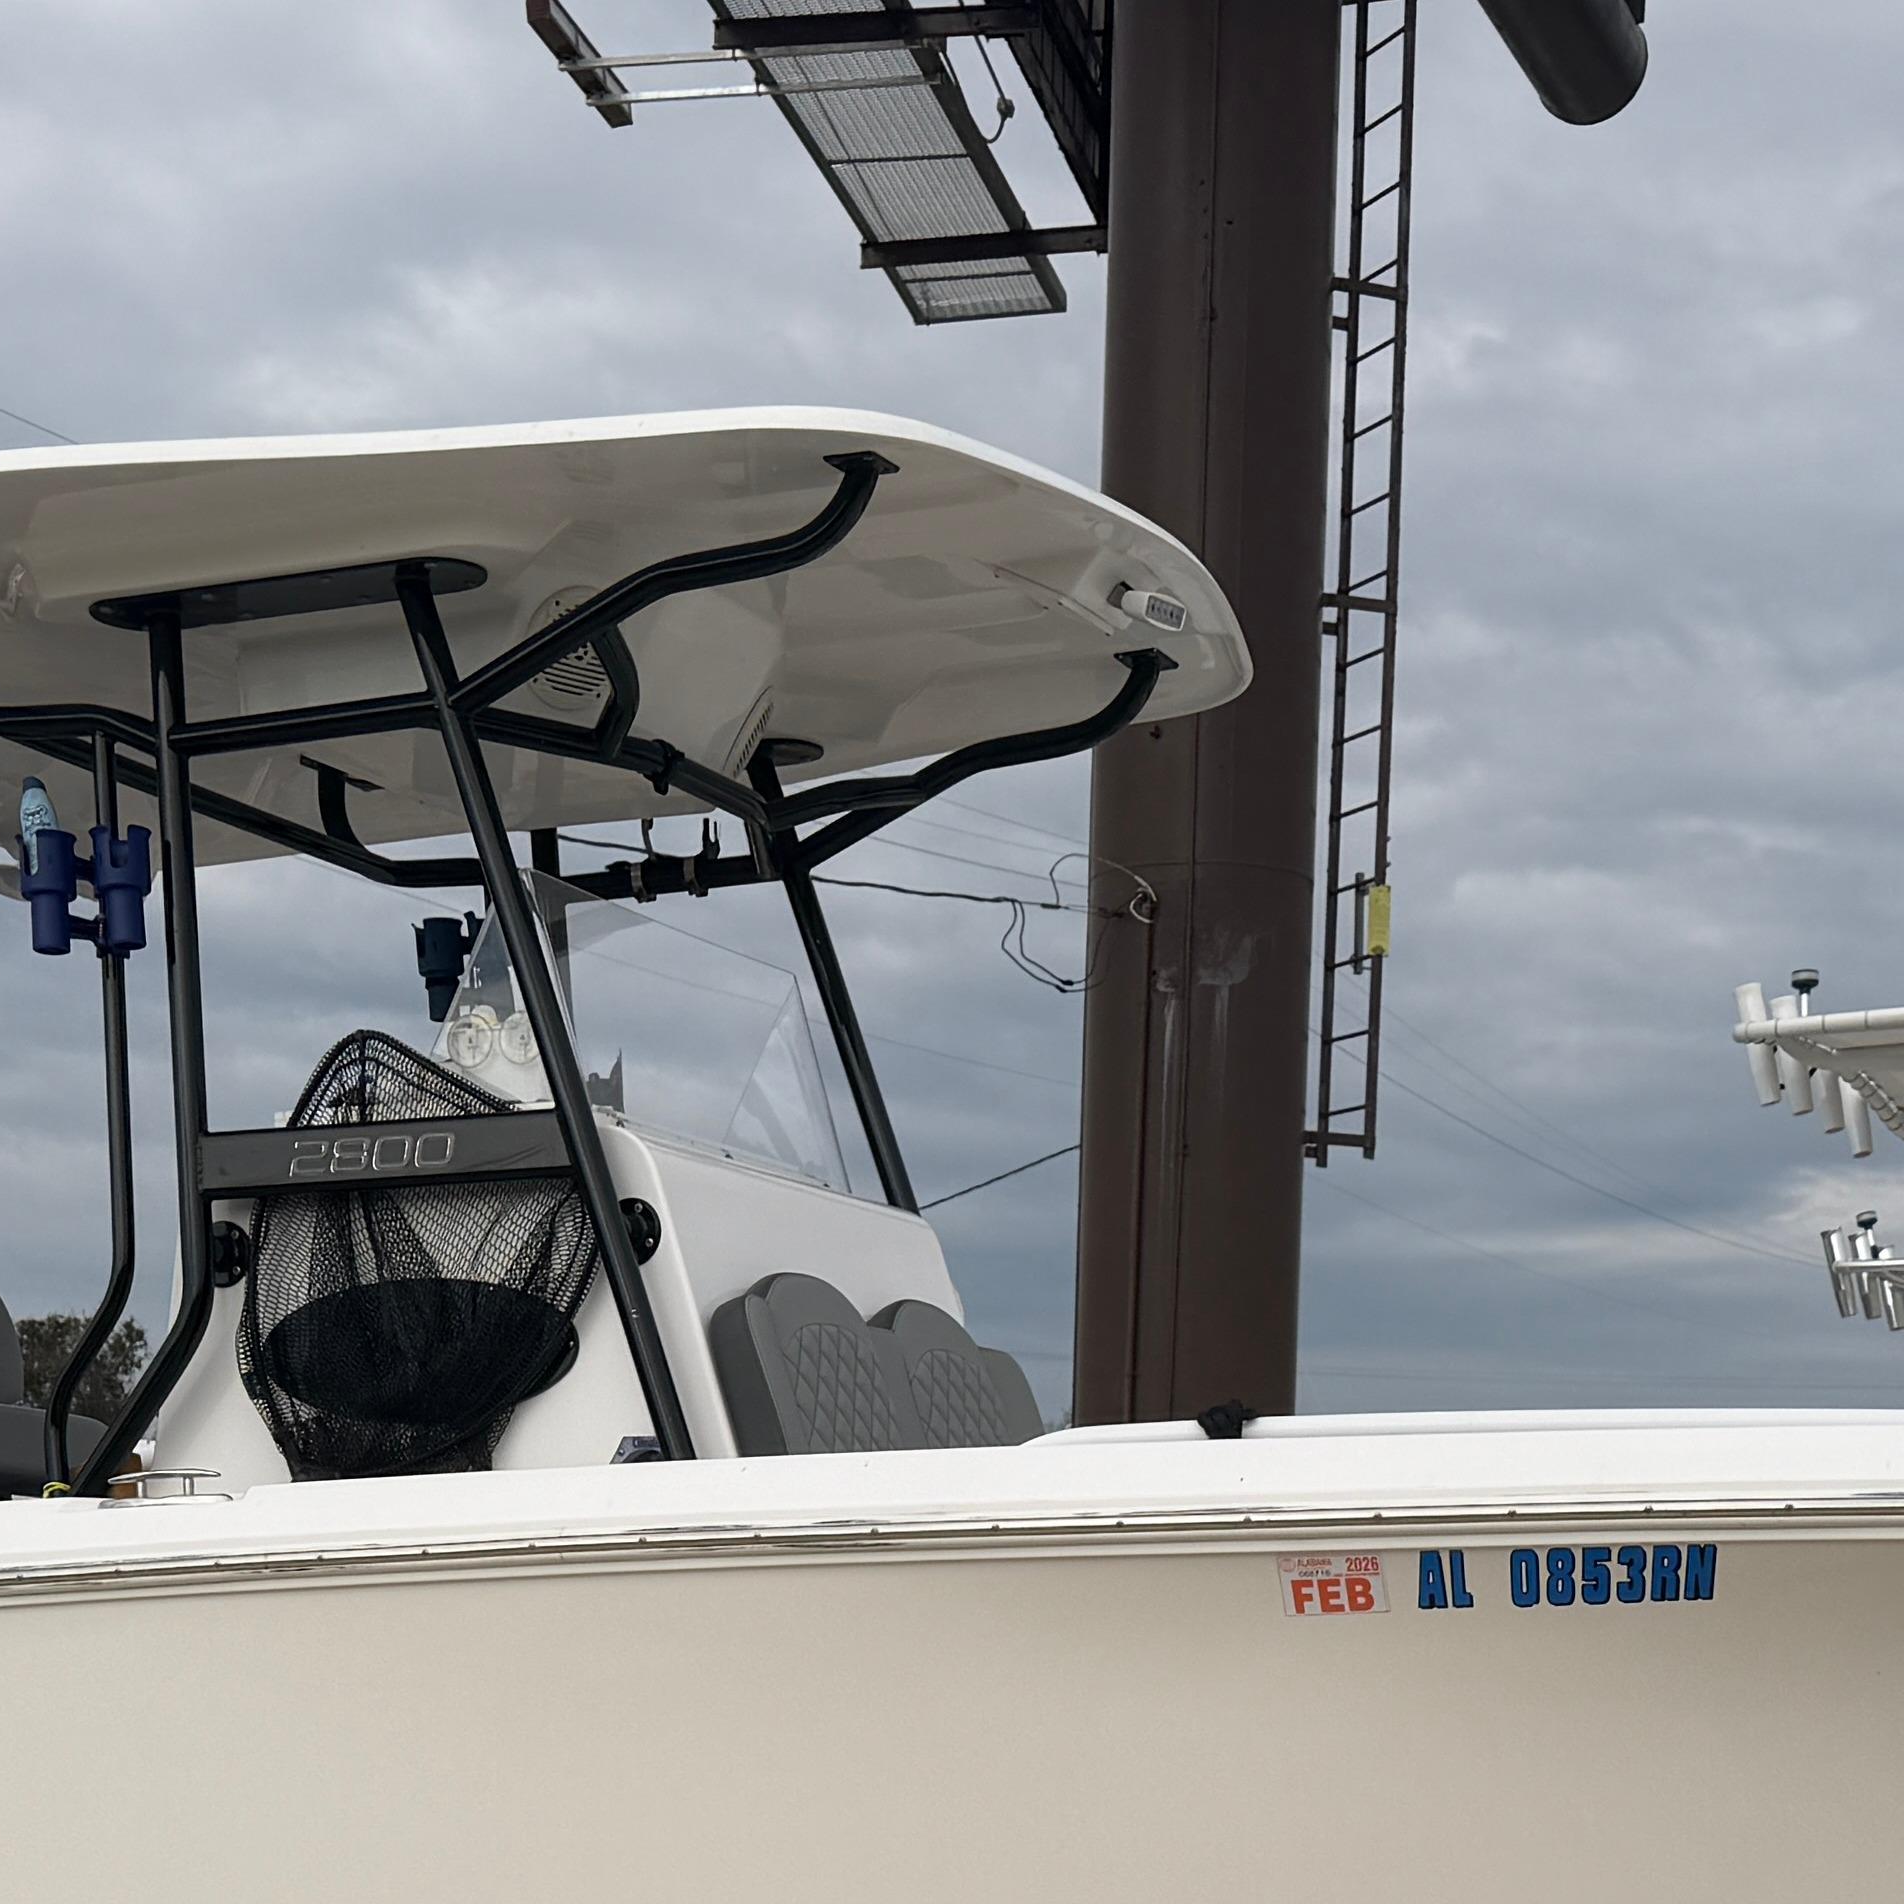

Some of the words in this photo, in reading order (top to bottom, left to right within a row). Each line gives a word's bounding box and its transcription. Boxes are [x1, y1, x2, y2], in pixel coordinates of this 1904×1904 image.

[289, 1133, 455, 1177] 2800
[1345, 1555, 1379, 1572] 2026
[1418, 1549, 1474, 1609] AL
[1508, 1543, 1718, 1608] 0853RN
[1291, 1578, 1375, 1614] FEB
